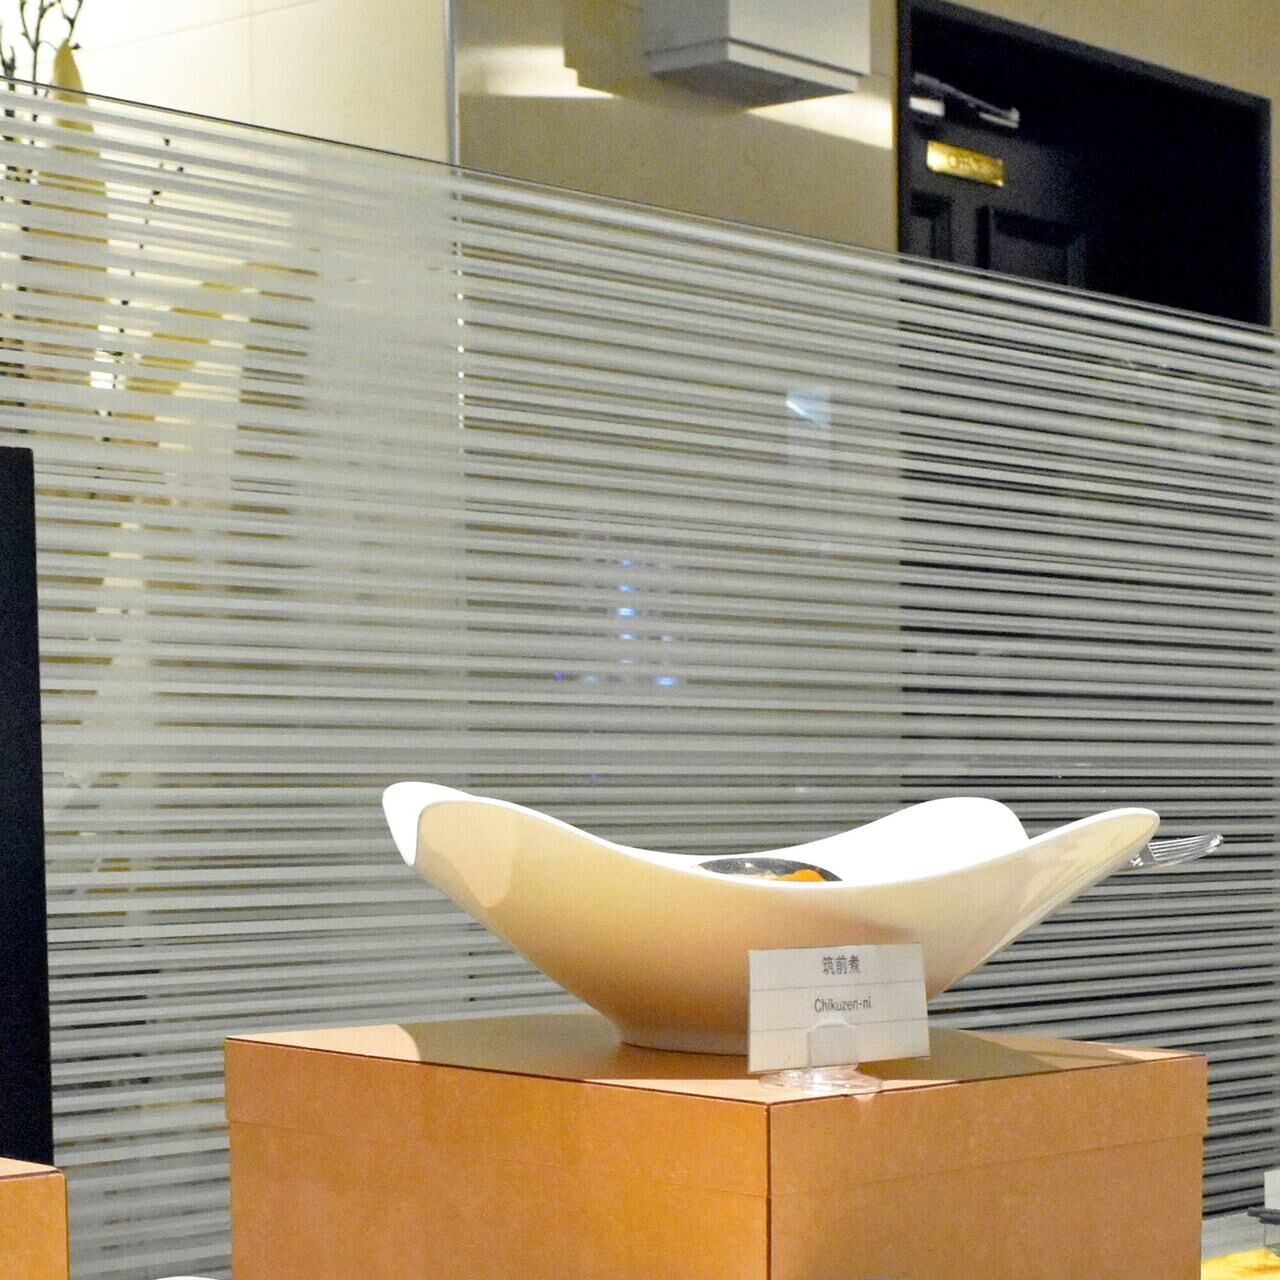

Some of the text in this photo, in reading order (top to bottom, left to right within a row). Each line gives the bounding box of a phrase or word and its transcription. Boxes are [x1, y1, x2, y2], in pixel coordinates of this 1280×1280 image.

[822, 954, 861, 976] 筑前煮
[814, 996, 872, 1013] Chikuzen-ni
